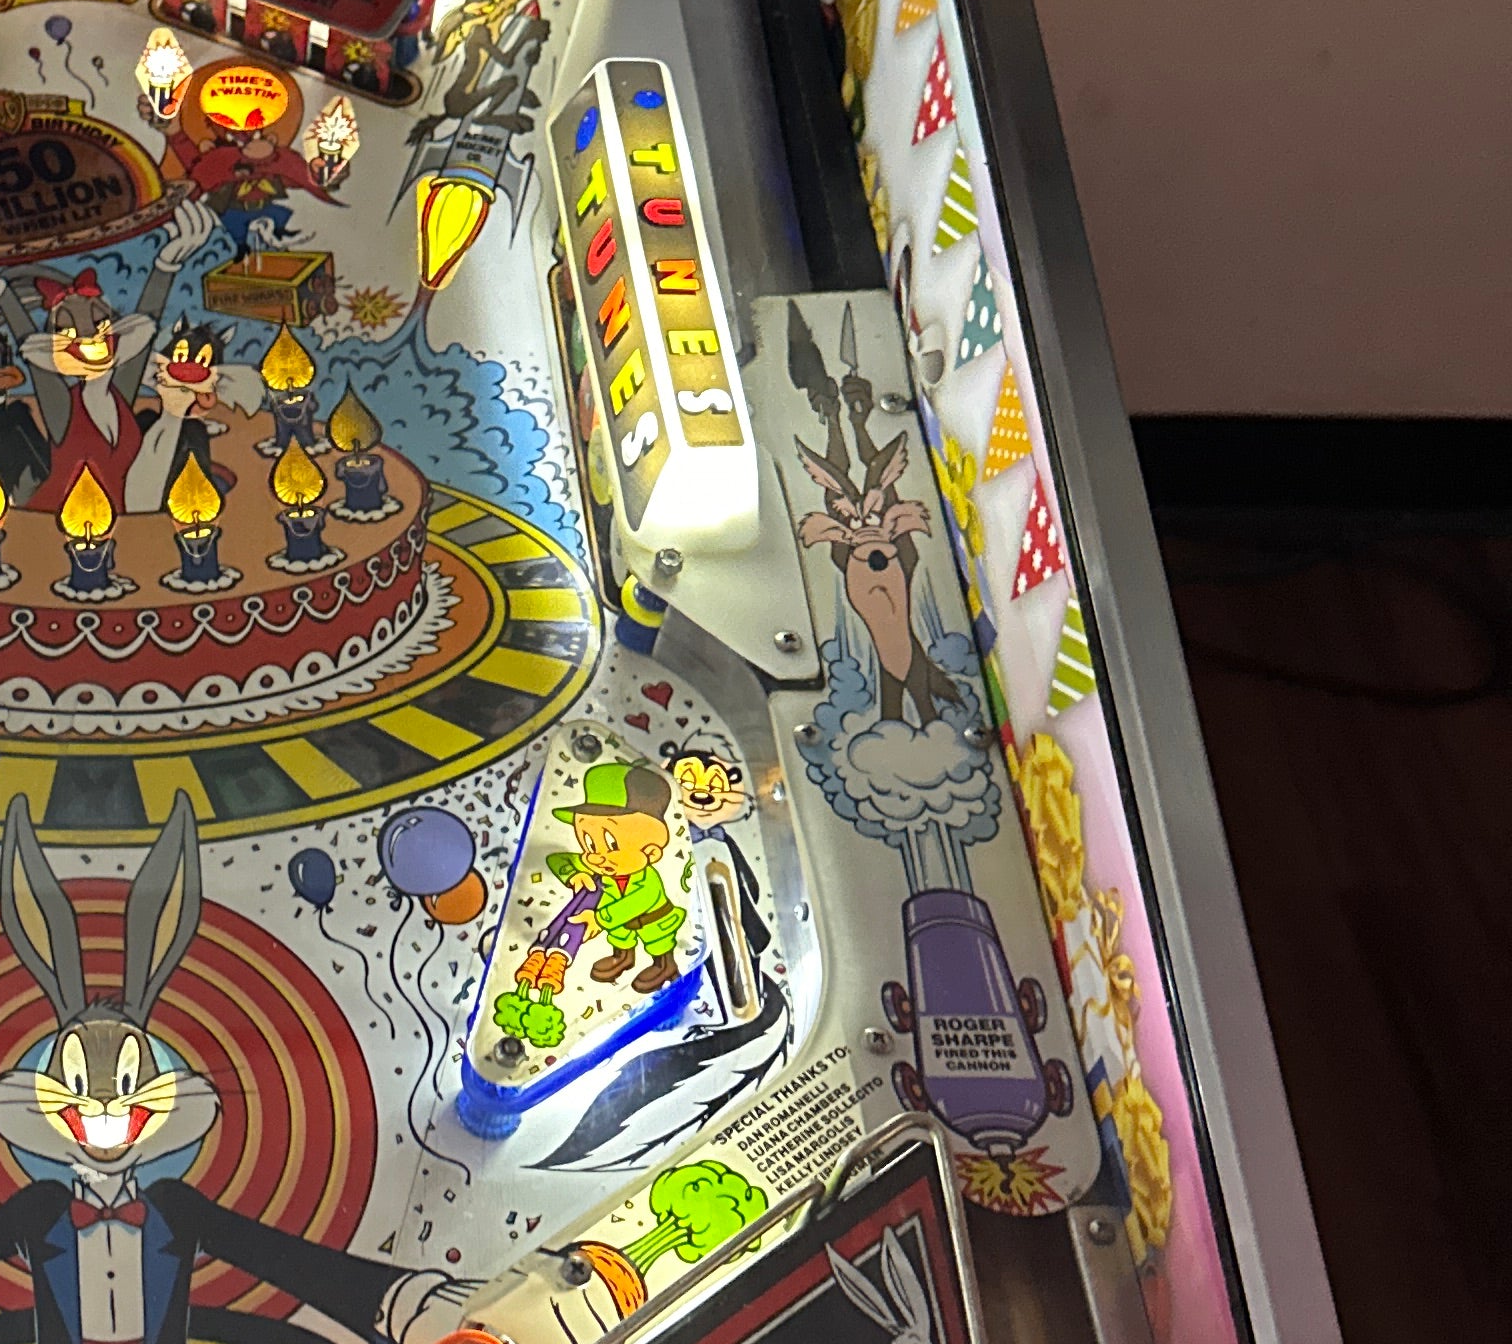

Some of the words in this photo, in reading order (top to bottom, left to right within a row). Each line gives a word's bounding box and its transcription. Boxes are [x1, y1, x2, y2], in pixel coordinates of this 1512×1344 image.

[218, 75, 274, 86] TIME'S
[31, 117, 123, 148] BIRTHDAY
[1, 212, 67, 235] WHEN
[72, 205, 102, 221] LIT
[631, 142, 734, 414] TUNES
[931, 1034, 1015, 1047] SHARPE
[934, 1018, 1006, 1031] ROGER
[935, 1048, 979, 1059] FIRED
[981, 1049, 1017, 1059] THIS
[945, 1060, 1011, 1071] CANNON
[714, 1100, 775, 1145] SPECIAL
[770, 1060, 829, 1104] THANKS
[825, 1045, 852, 1064] TO:
[737, 1128, 765, 1152] DAN
[763, 1081, 830, 1134] ROMANELLI
[746, 1131, 789, 1163] LUANA
[787, 1083, 851, 1133] CHAMBERS
[756, 1121, 823, 1173] CATHERINE
[821, 1076, 884, 1125] SOLLECITO
[765, 1160, 796, 1185] LISA
[792, 1115, 855, 1164] MARGOLIS
[775, 1161, 815, 1196] KELLY
[812, 1125, 863, 1168] LINDSEY
